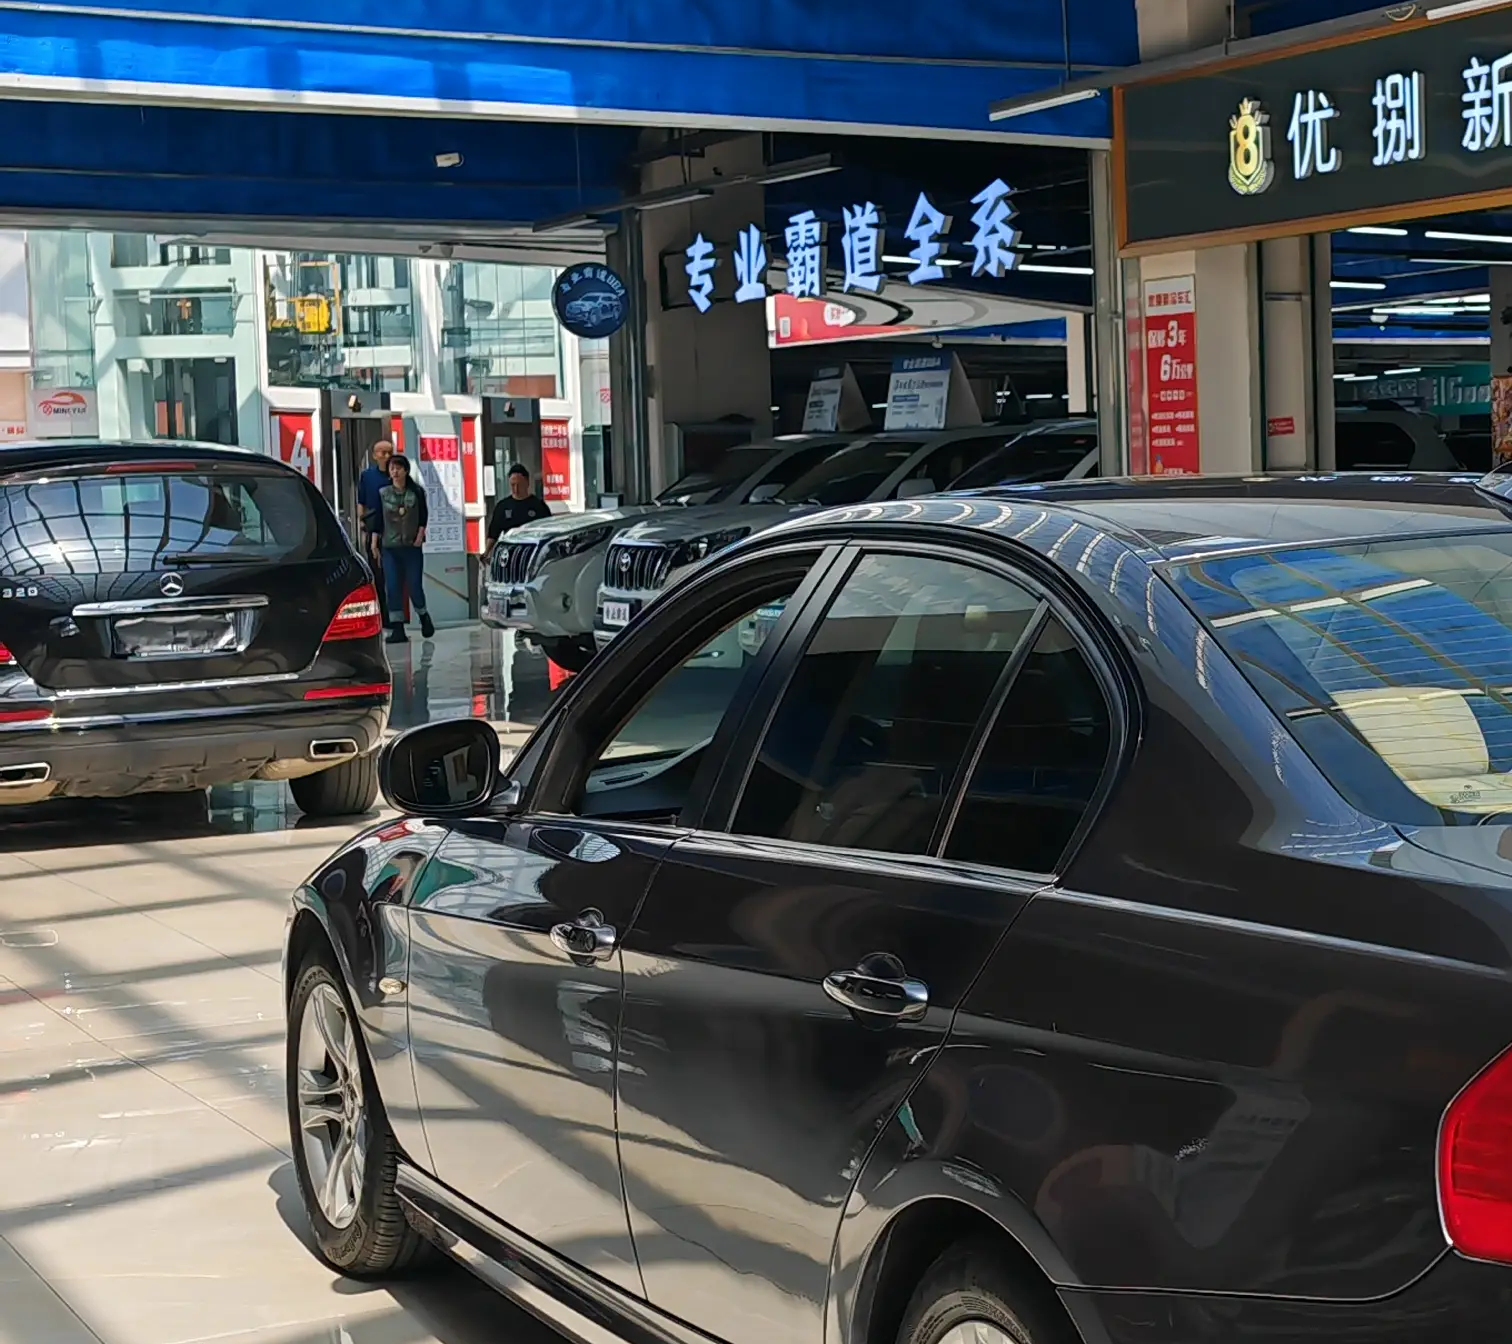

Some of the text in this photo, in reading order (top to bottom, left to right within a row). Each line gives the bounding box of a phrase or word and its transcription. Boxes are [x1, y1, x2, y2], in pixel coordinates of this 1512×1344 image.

[685, 178, 1017, 313] 专业霸道全系
